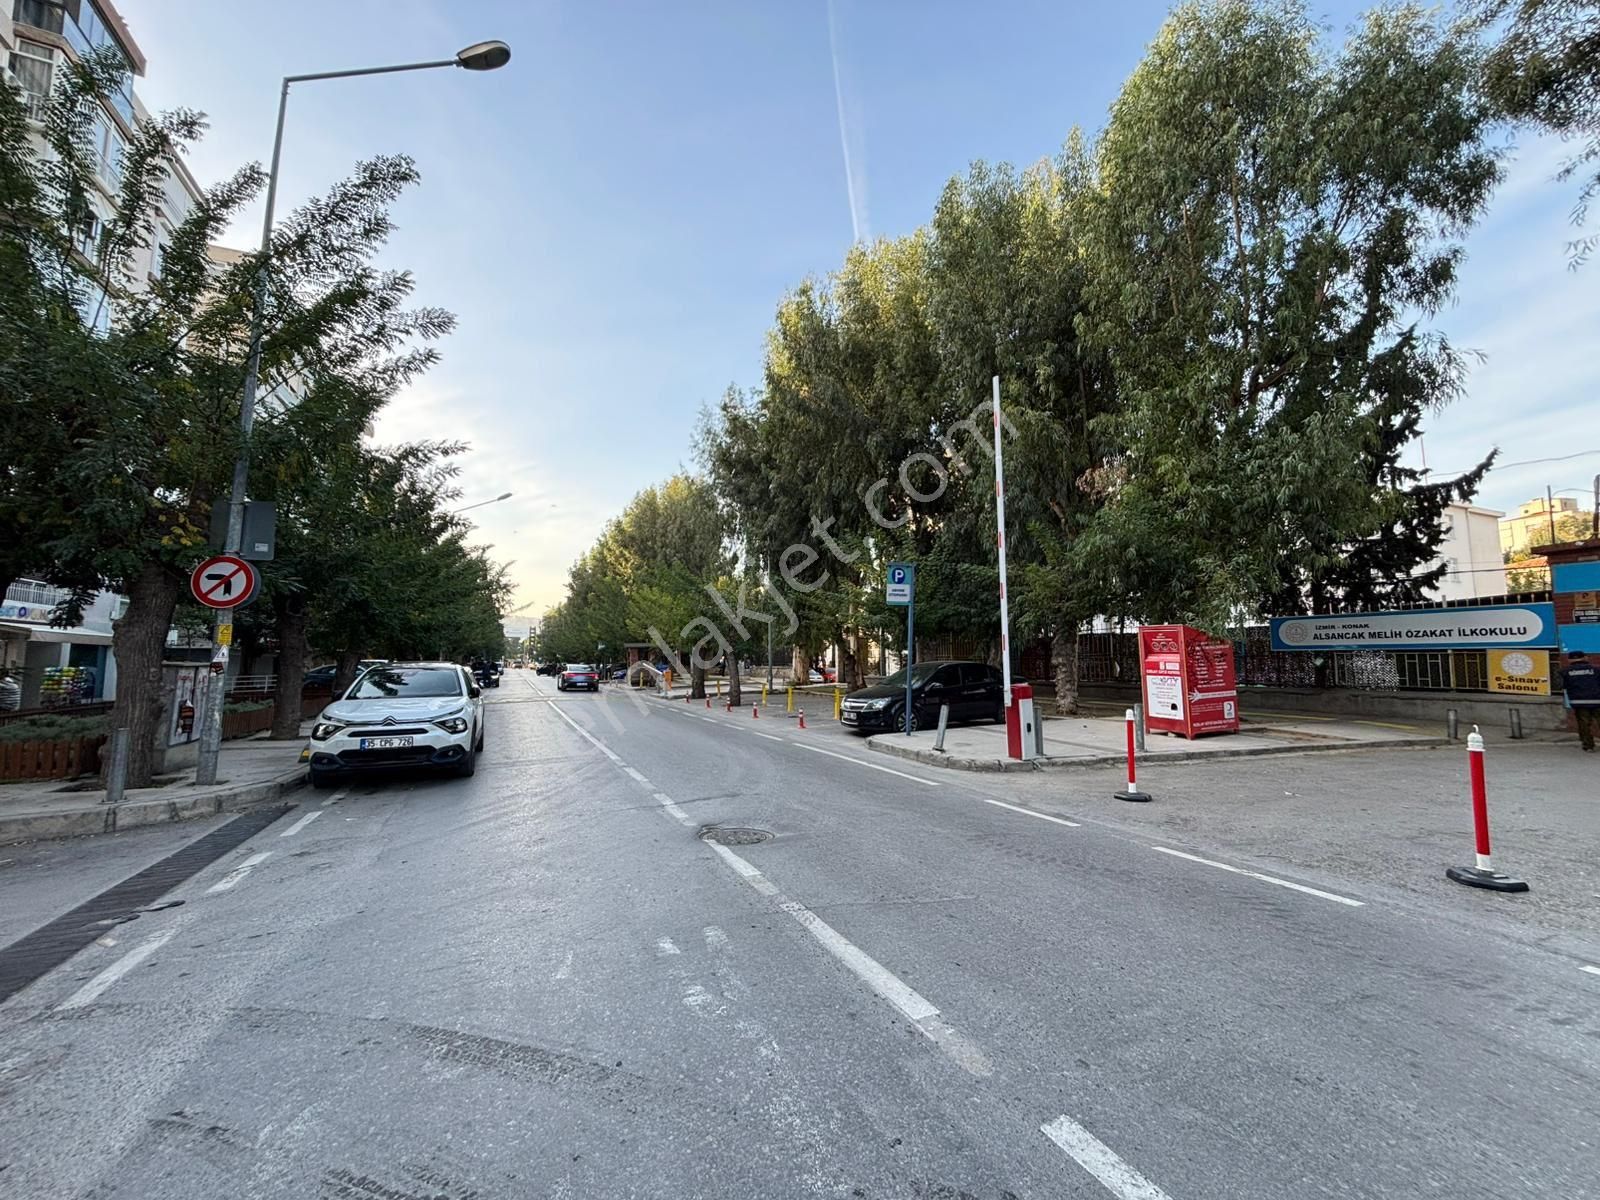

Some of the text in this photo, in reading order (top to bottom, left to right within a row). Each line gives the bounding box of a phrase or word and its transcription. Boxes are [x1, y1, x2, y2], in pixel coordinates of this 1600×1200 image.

[895, 569, 904, 582] P
[1312, 631, 1366, 641] ALSANCAK
[1368, 629, 1402, 639] MELİH
[1458, 625, 1528, 637] İLKOKULU
[1497, 682, 1538, 692] Salonu
[398, 738, 411, 746] 726
